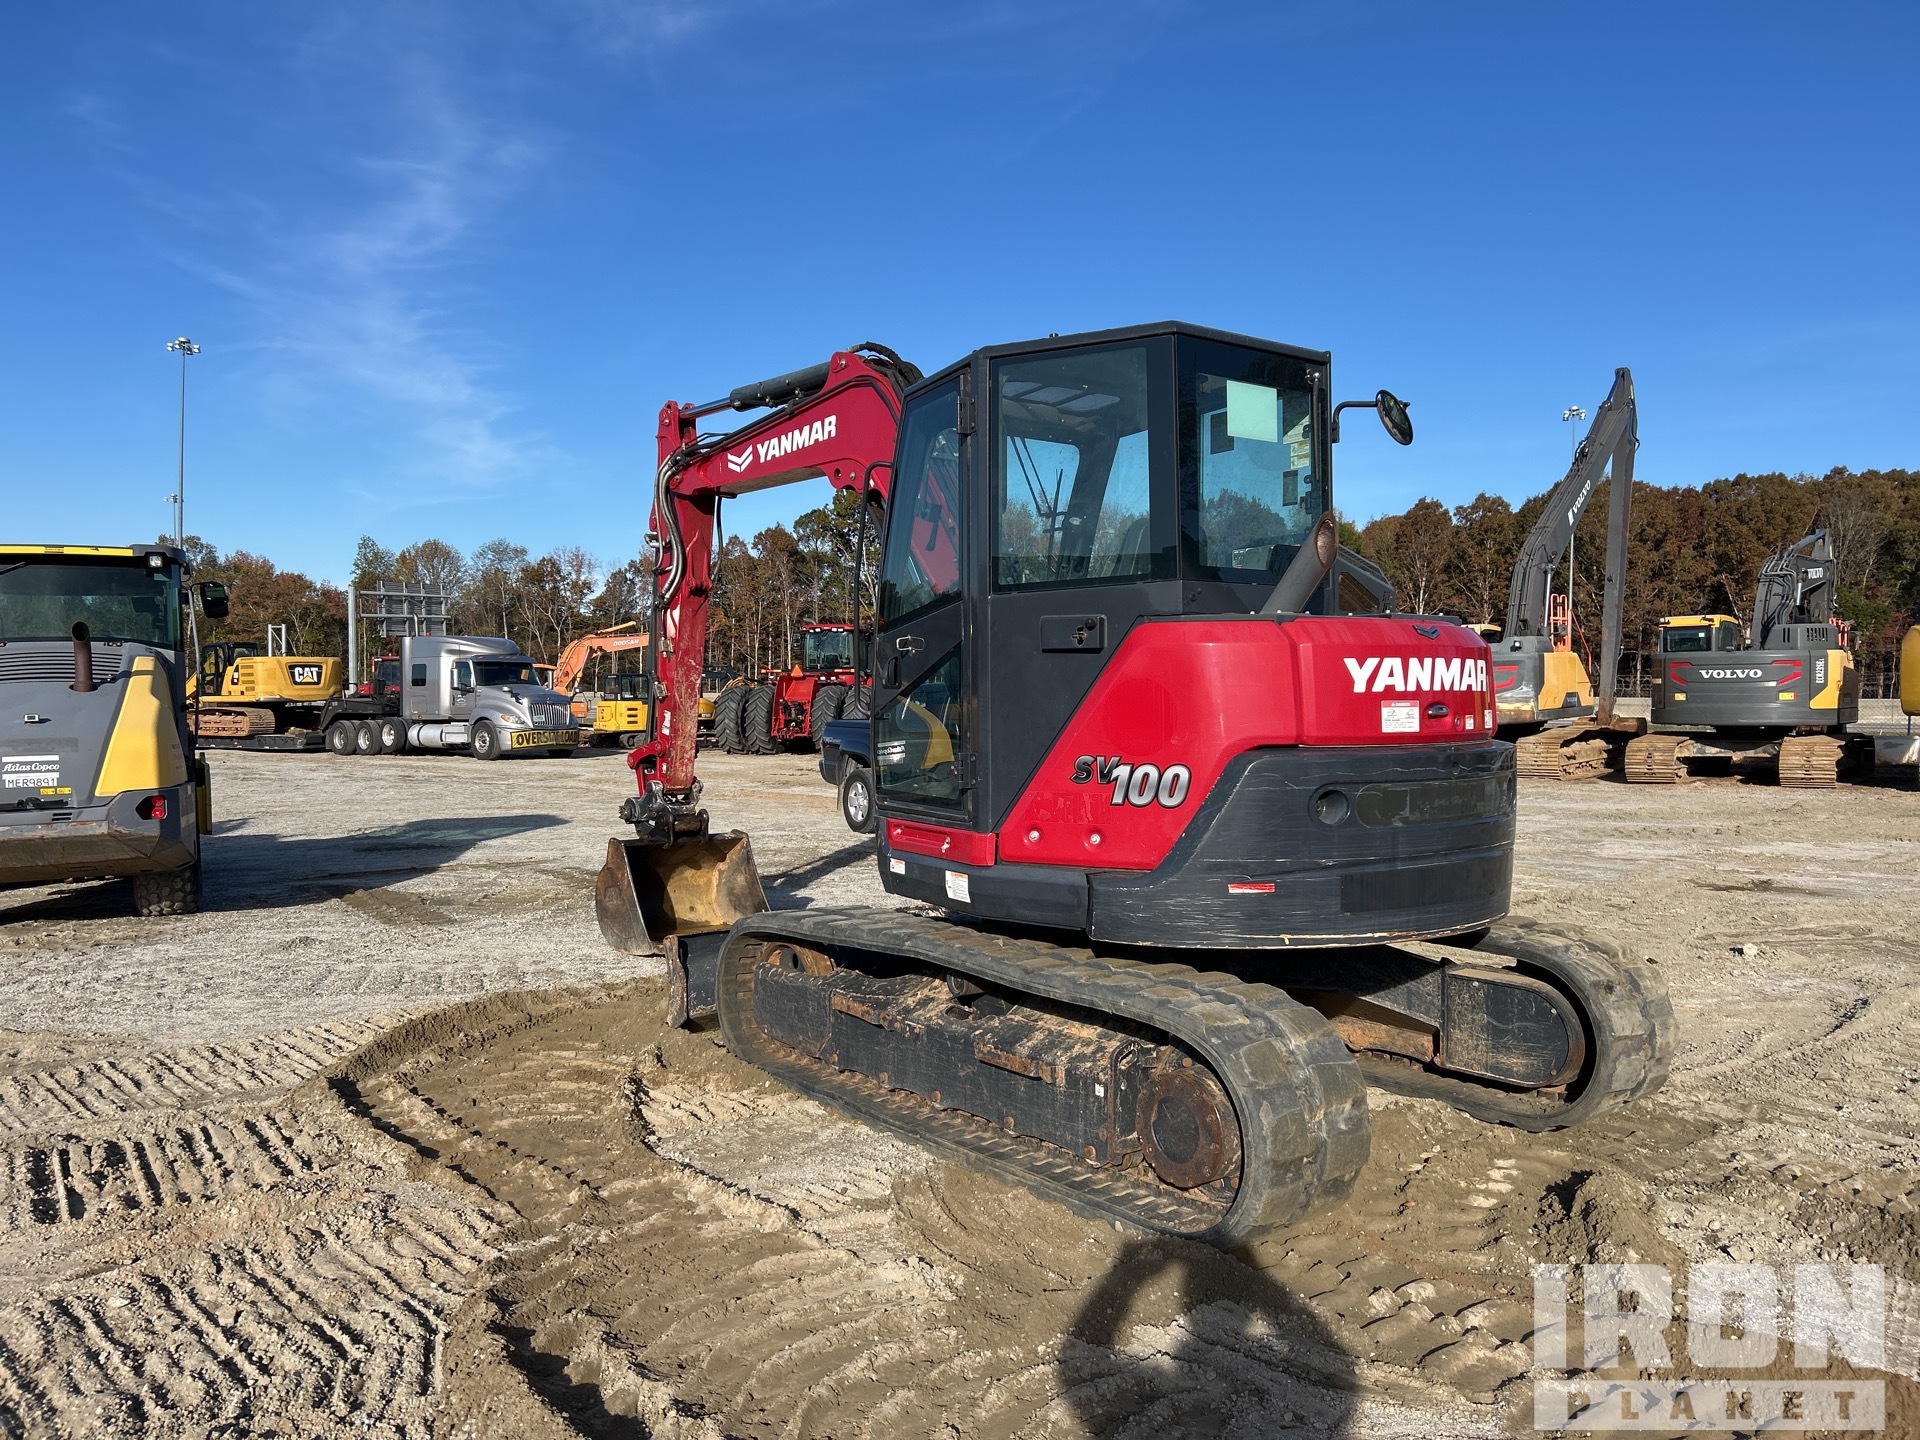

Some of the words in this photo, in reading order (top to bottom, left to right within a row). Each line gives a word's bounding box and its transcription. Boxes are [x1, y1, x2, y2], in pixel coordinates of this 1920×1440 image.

[756, 415, 837, 464] YANMAR
[1572, 479, 1591, 514] VOLVO
[613, 639, 640, 647] DOOSAN
[294, 666, 319, 683] CAT
[1343, 657, 1487, 693] YANMAR
[1698, 669, 1763, 679] VOLVO
[561, 730, 578, 743] LOAD
[2, 763, 31, 772] Atlas
[31, 762, 60, 772] Copco
[8, 777, 56, 788] MER9891
